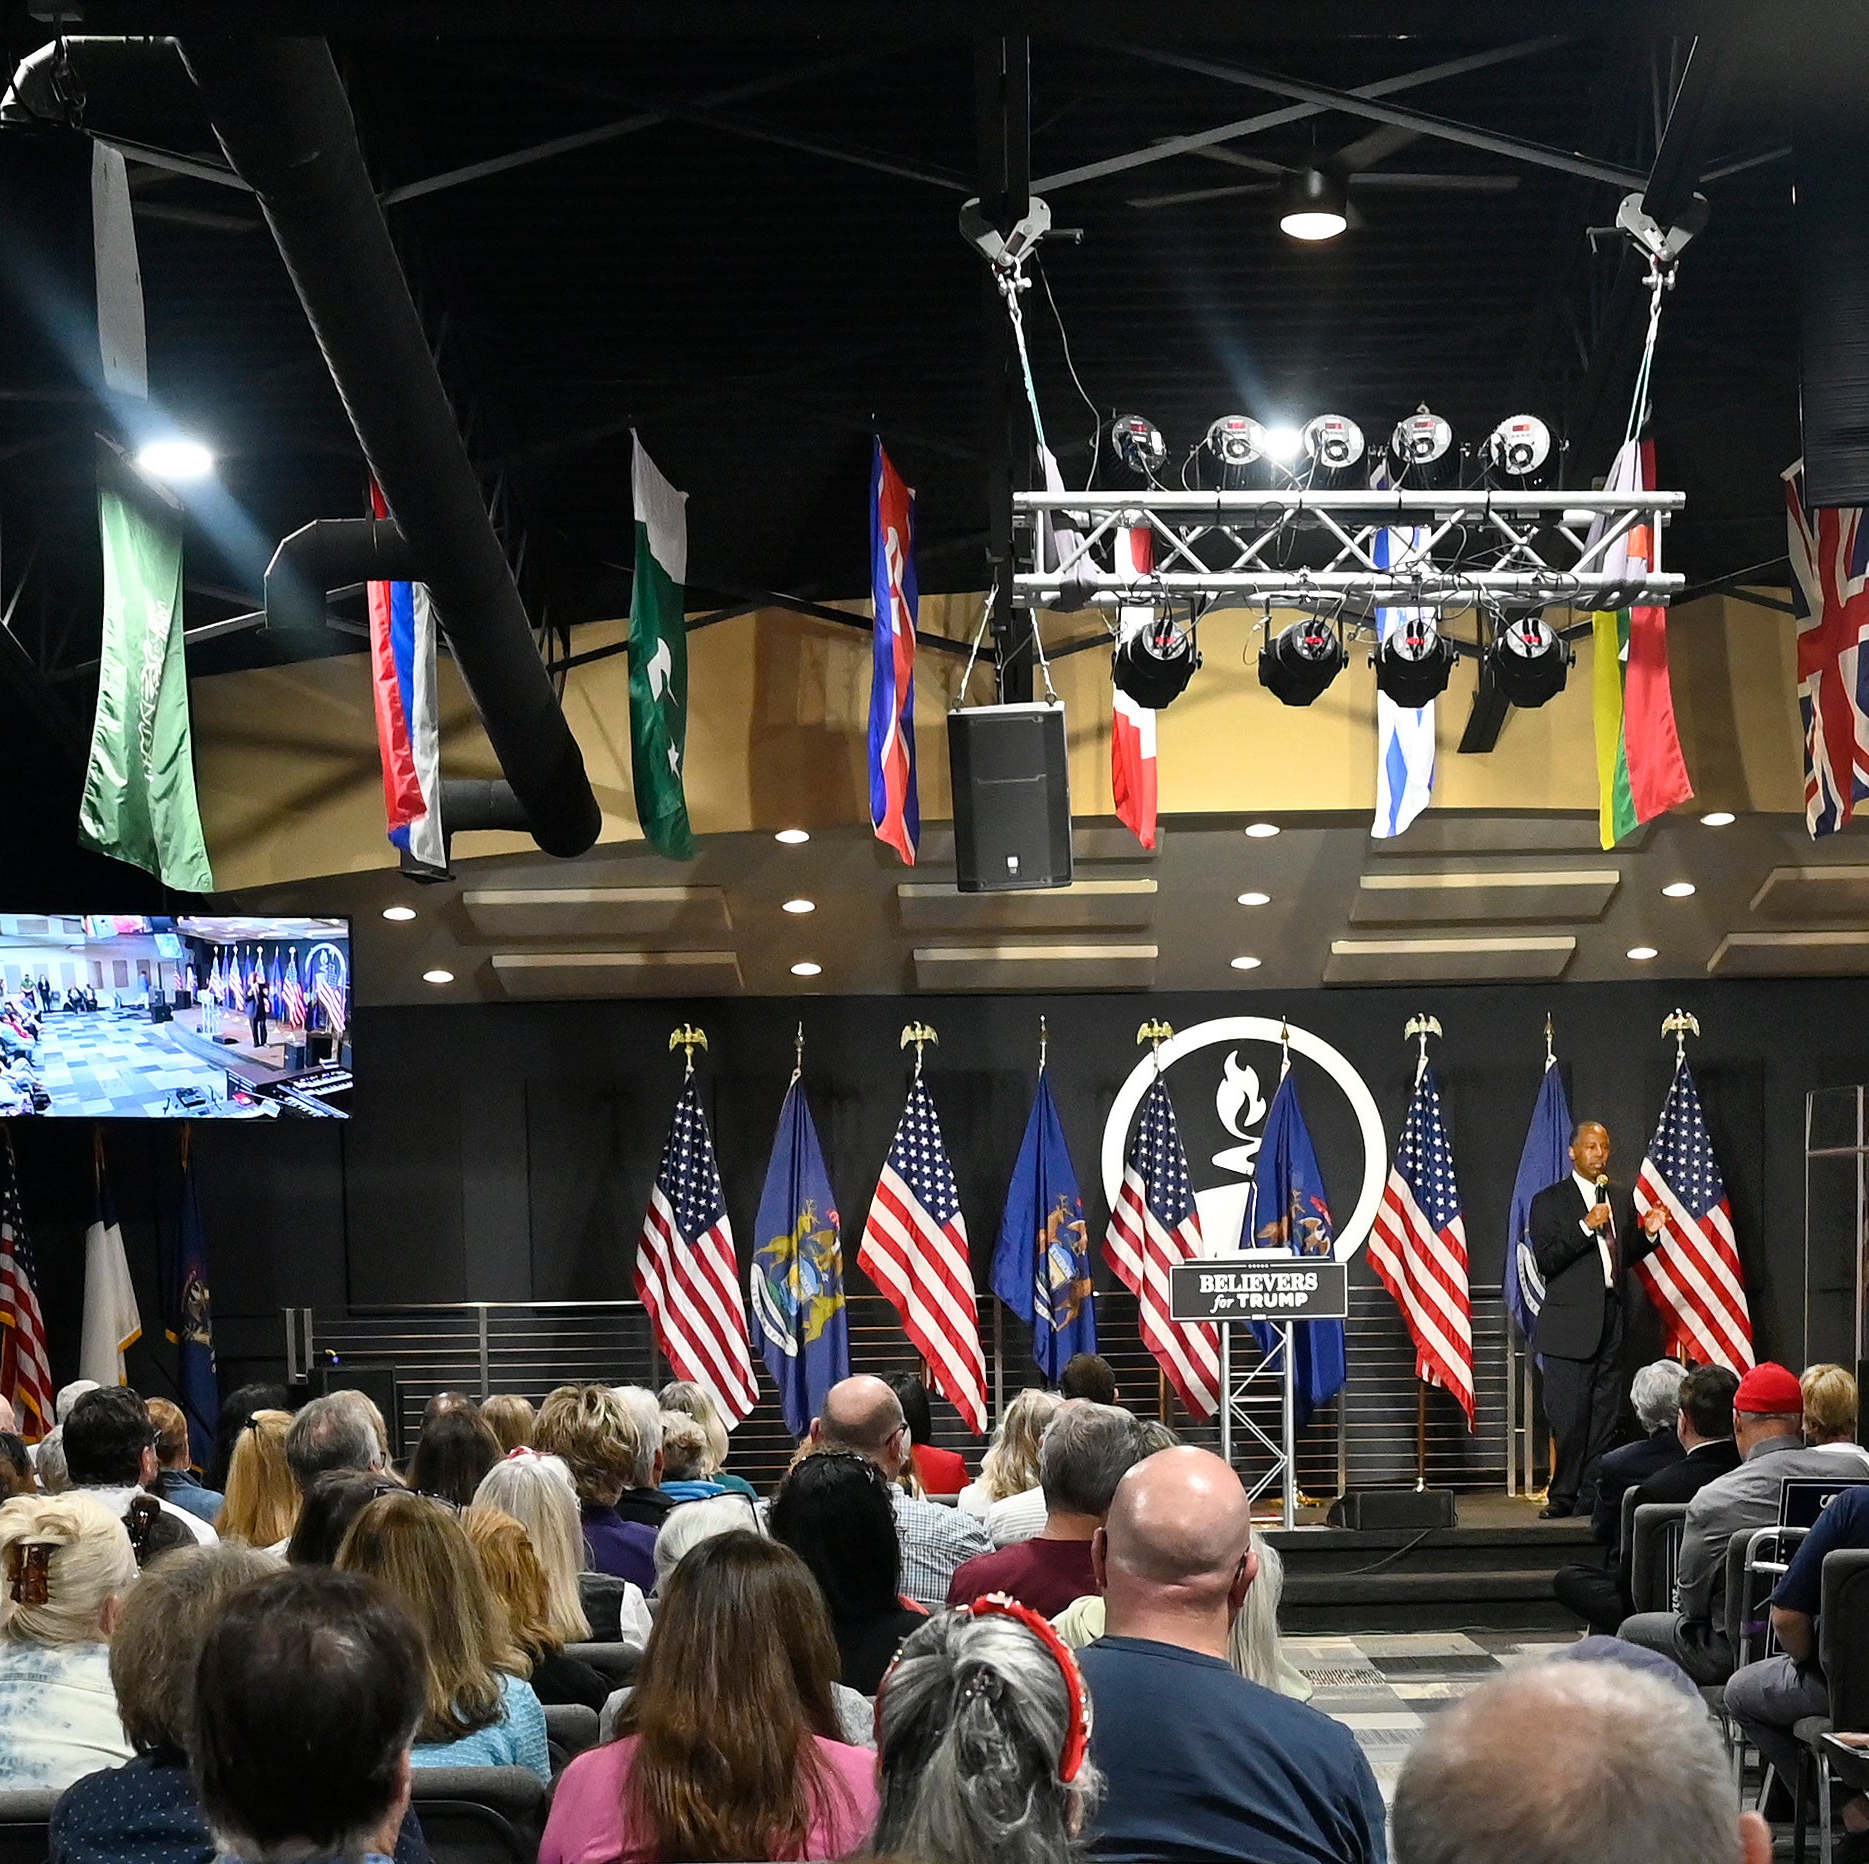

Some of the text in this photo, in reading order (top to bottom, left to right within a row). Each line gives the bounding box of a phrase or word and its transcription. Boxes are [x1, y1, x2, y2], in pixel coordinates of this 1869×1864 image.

[1199, 1272, 1319, 1293] BELIEVERS
[1209, 1292, 1309, 1314] for TRUMP
